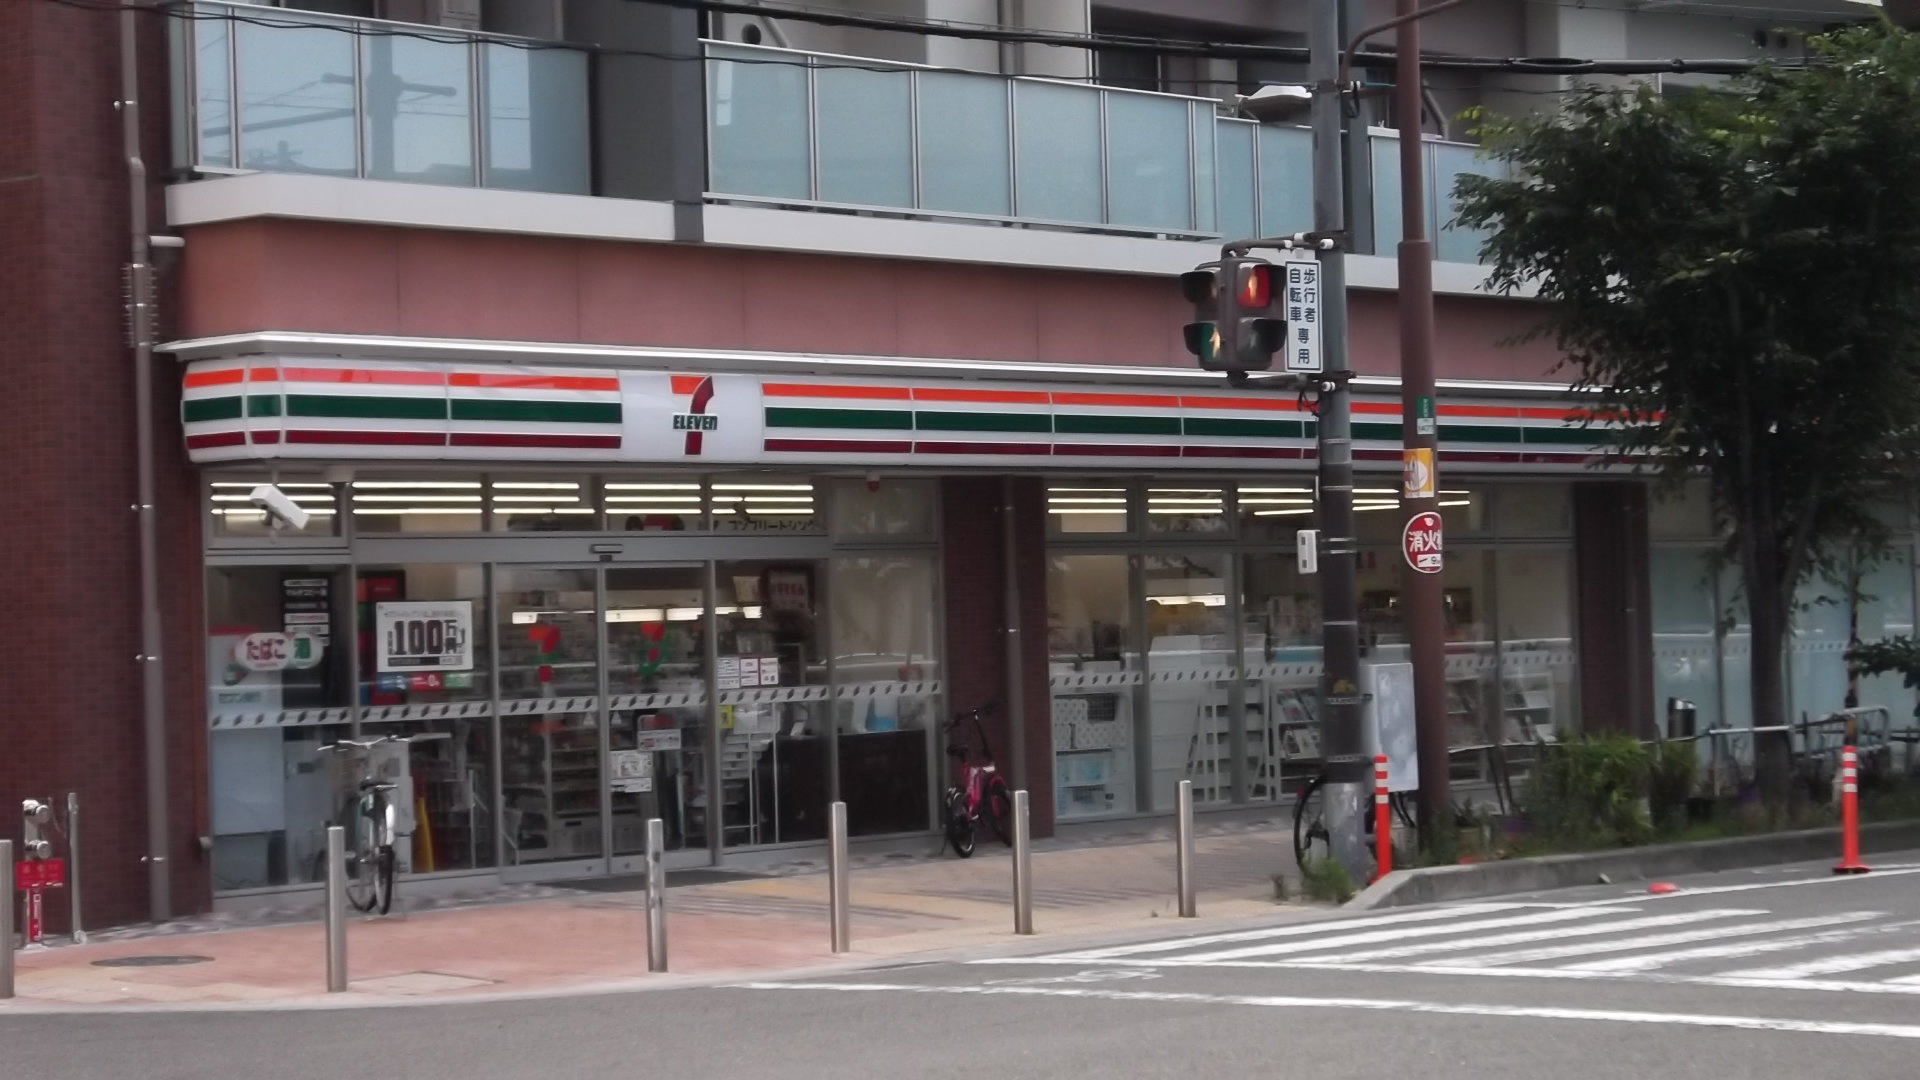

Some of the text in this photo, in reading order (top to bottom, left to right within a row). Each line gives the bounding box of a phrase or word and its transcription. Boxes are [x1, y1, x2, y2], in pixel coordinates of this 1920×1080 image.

[1289, 267, 1302, 322] 自転車
[1304, 268, 1316, 323] 歩行者
[1297, 327, 1310, 364] 専用
[246, 638, 286, 660] たばこ
